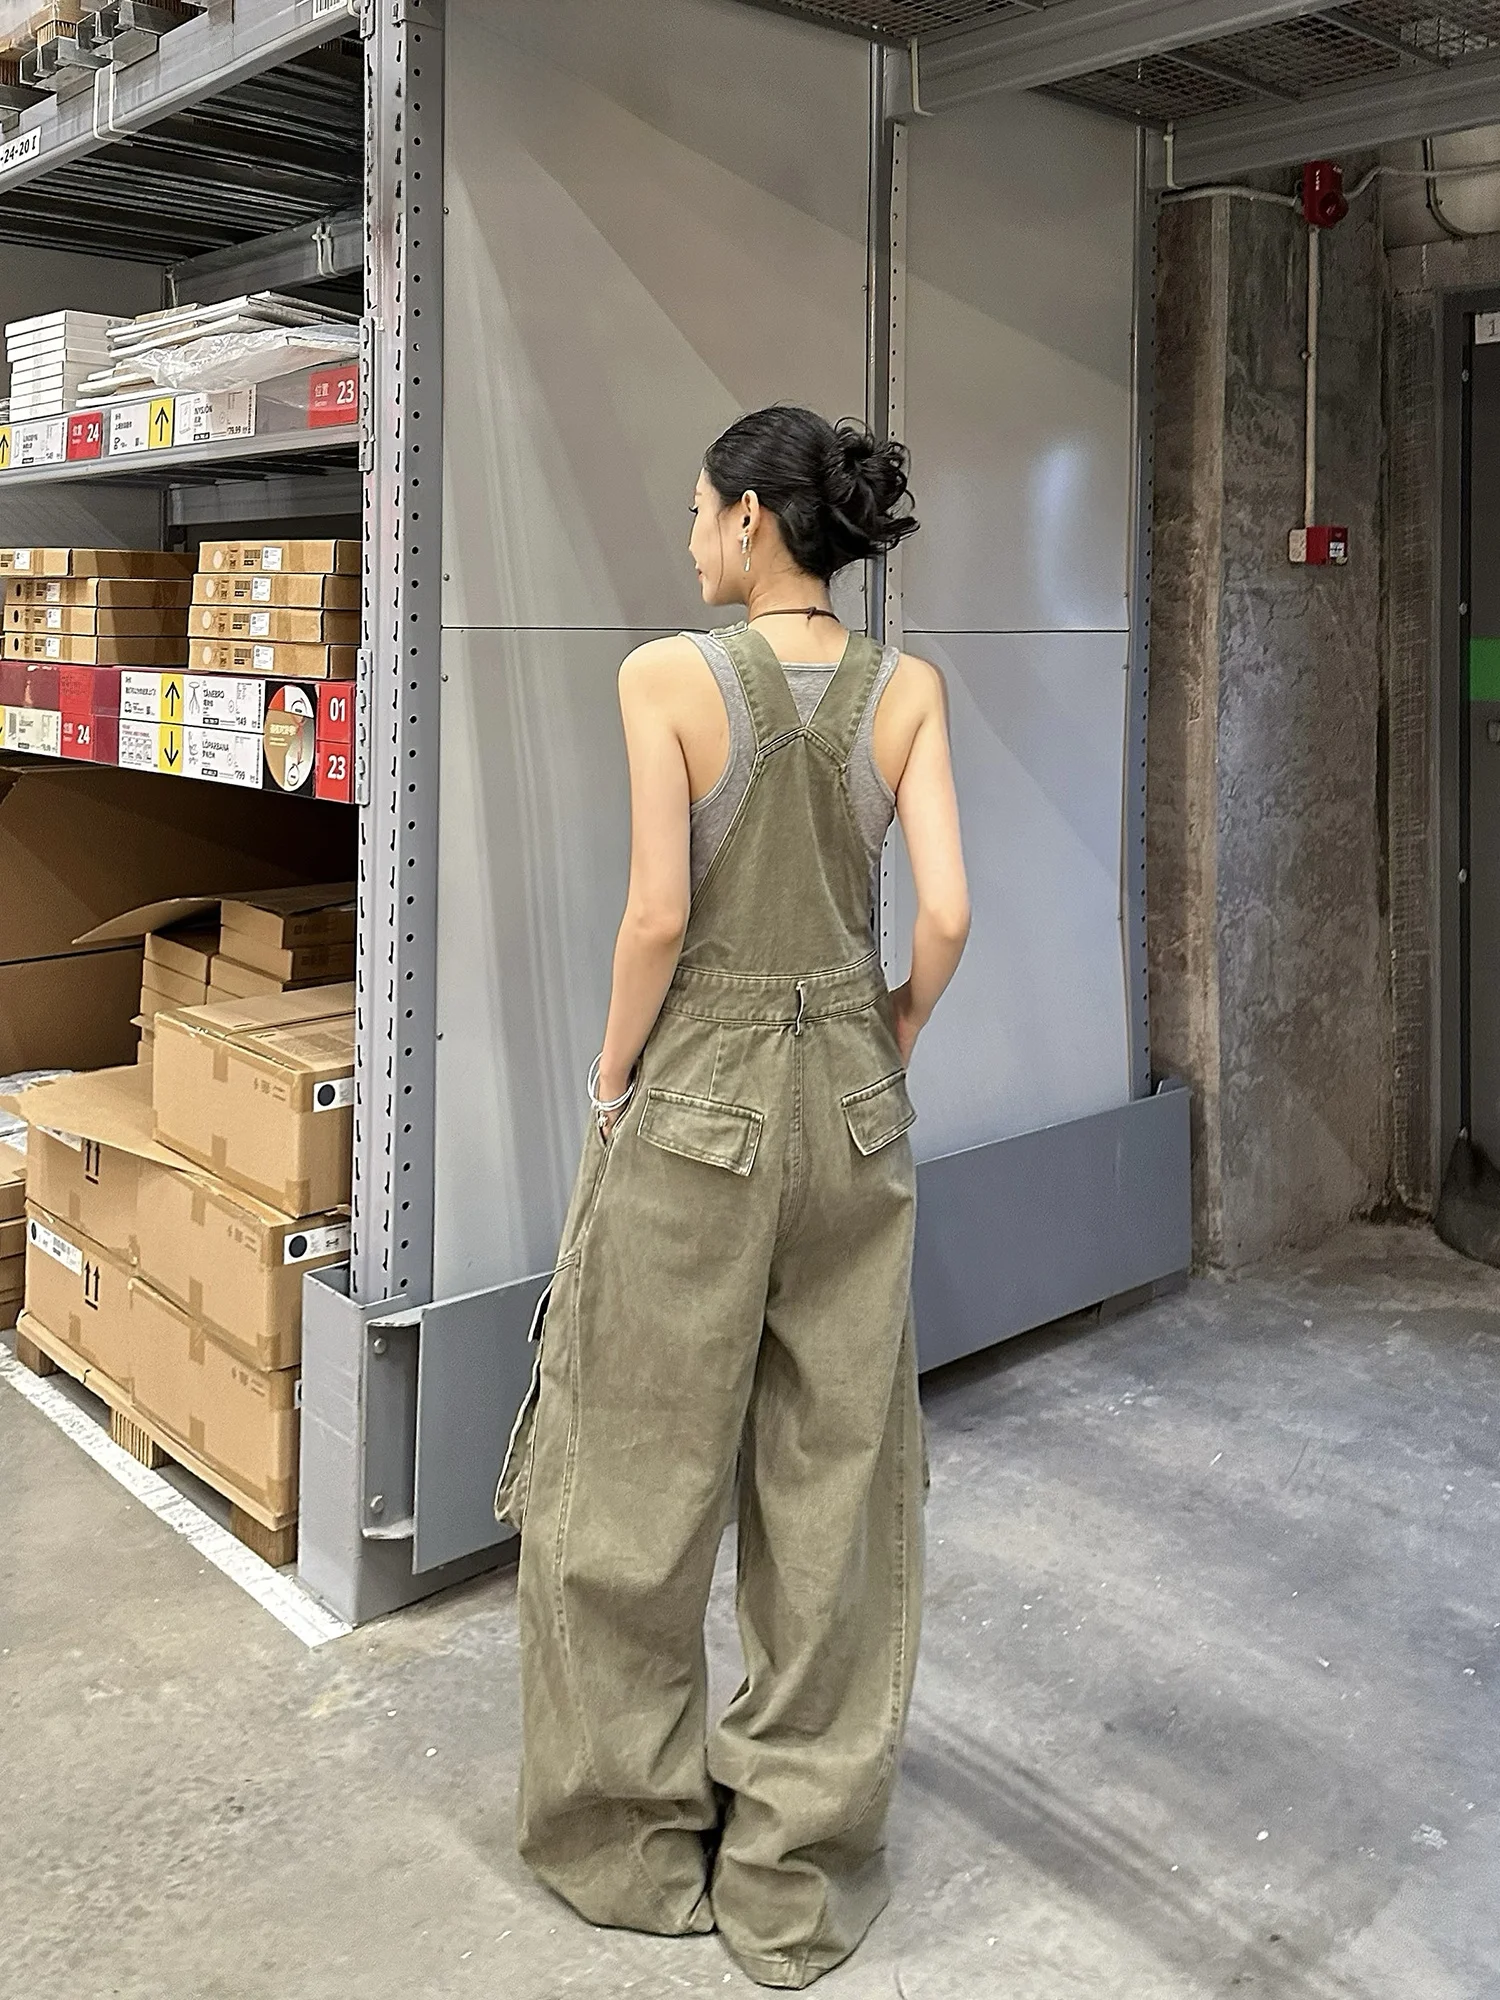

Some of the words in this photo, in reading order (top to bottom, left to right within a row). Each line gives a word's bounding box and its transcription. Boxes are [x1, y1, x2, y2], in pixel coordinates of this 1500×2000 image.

[336, 379, 355, 405] 23
[86, 423, 100, 443] 24
[329, 697, 346, 722] 01
[77, 724, 91, 744] 24
[327, 754, 346, 780] 23
